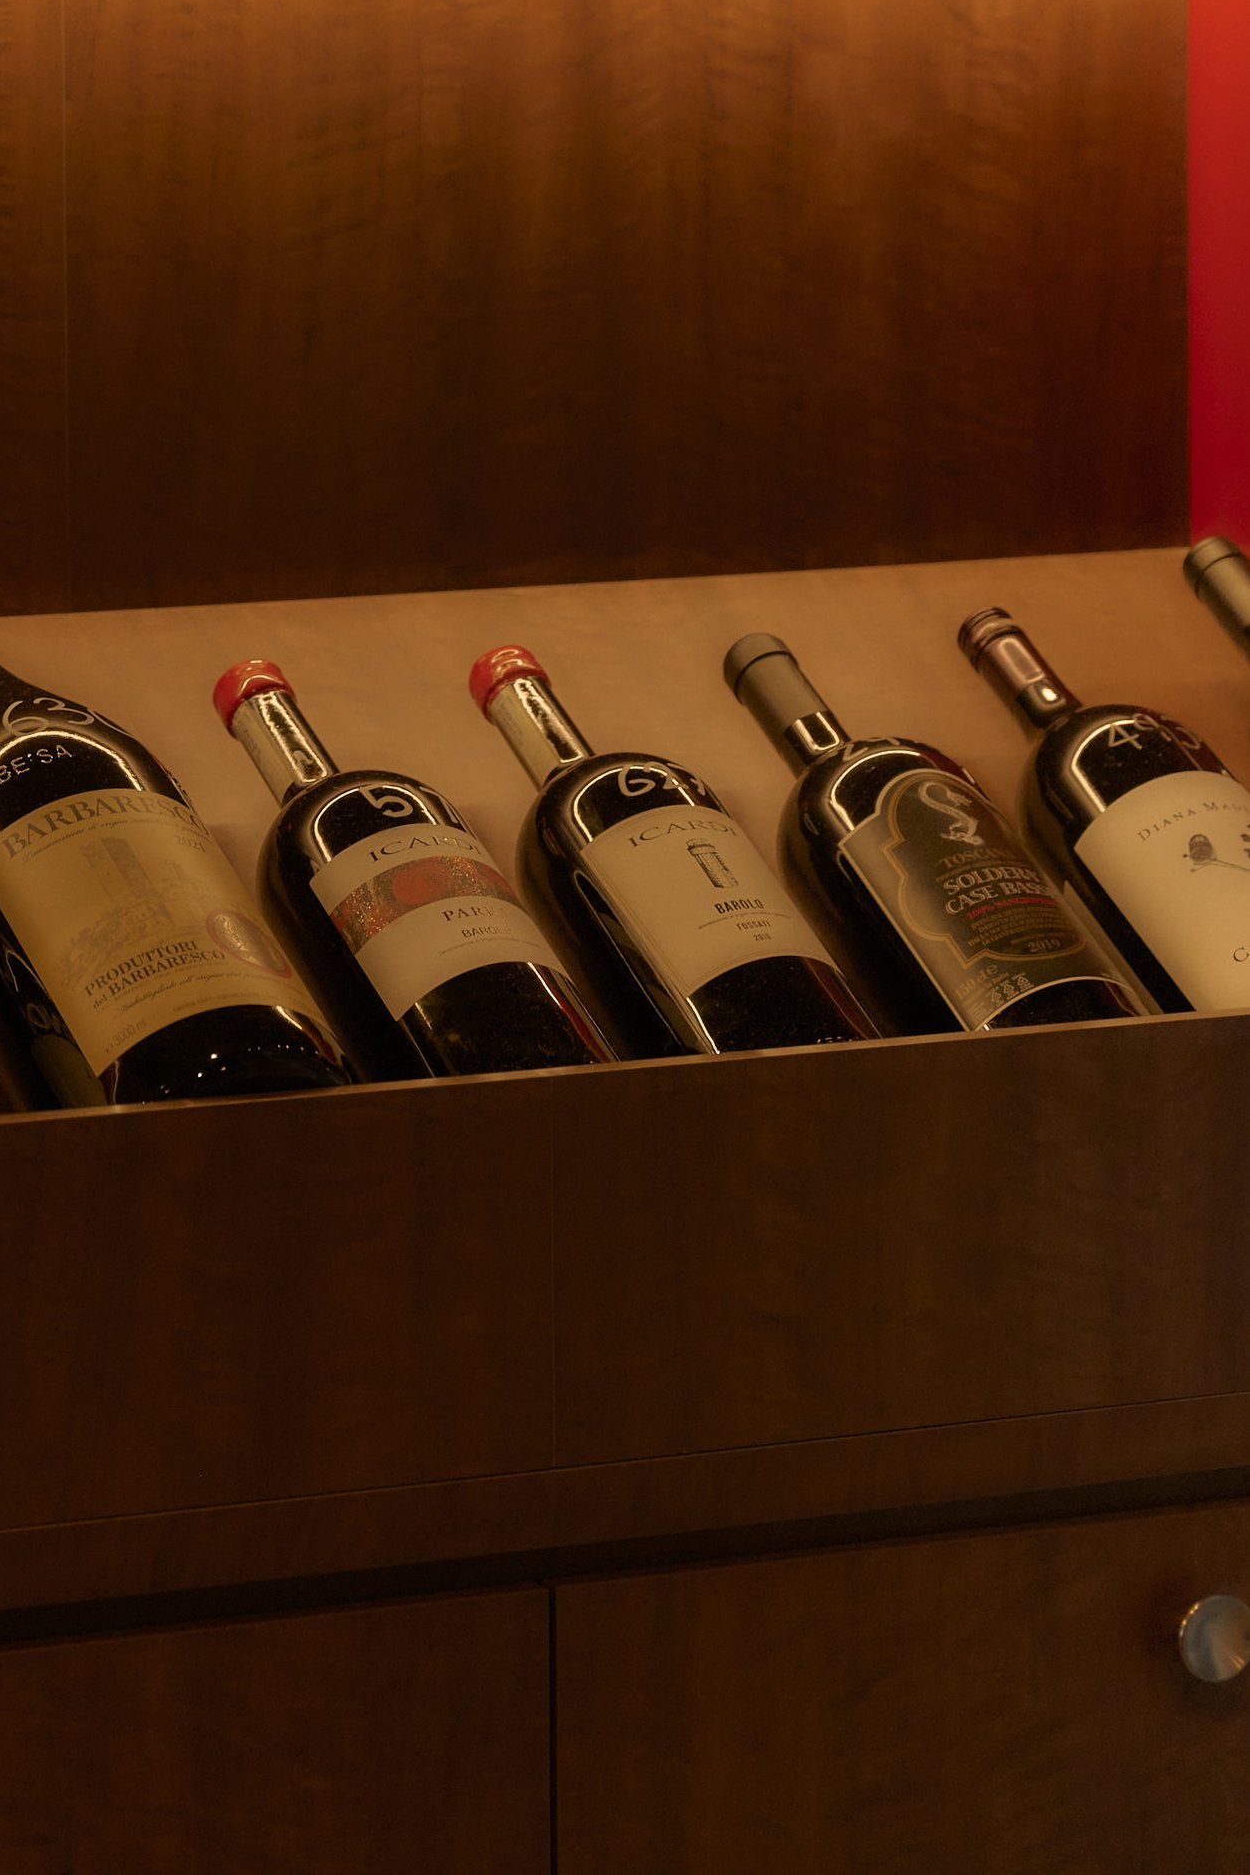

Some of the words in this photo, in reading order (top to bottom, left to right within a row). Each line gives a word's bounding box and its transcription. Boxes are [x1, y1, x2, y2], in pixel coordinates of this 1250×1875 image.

[1138, 808, 1196, 842] DIANA
[714, 898, 764, 915] BAROLO
[945, 883, 998, 915] CASE
[85, 940, 198, 997] PRODUTTORI
[108, 950, 225, 997] BARBARESCO
